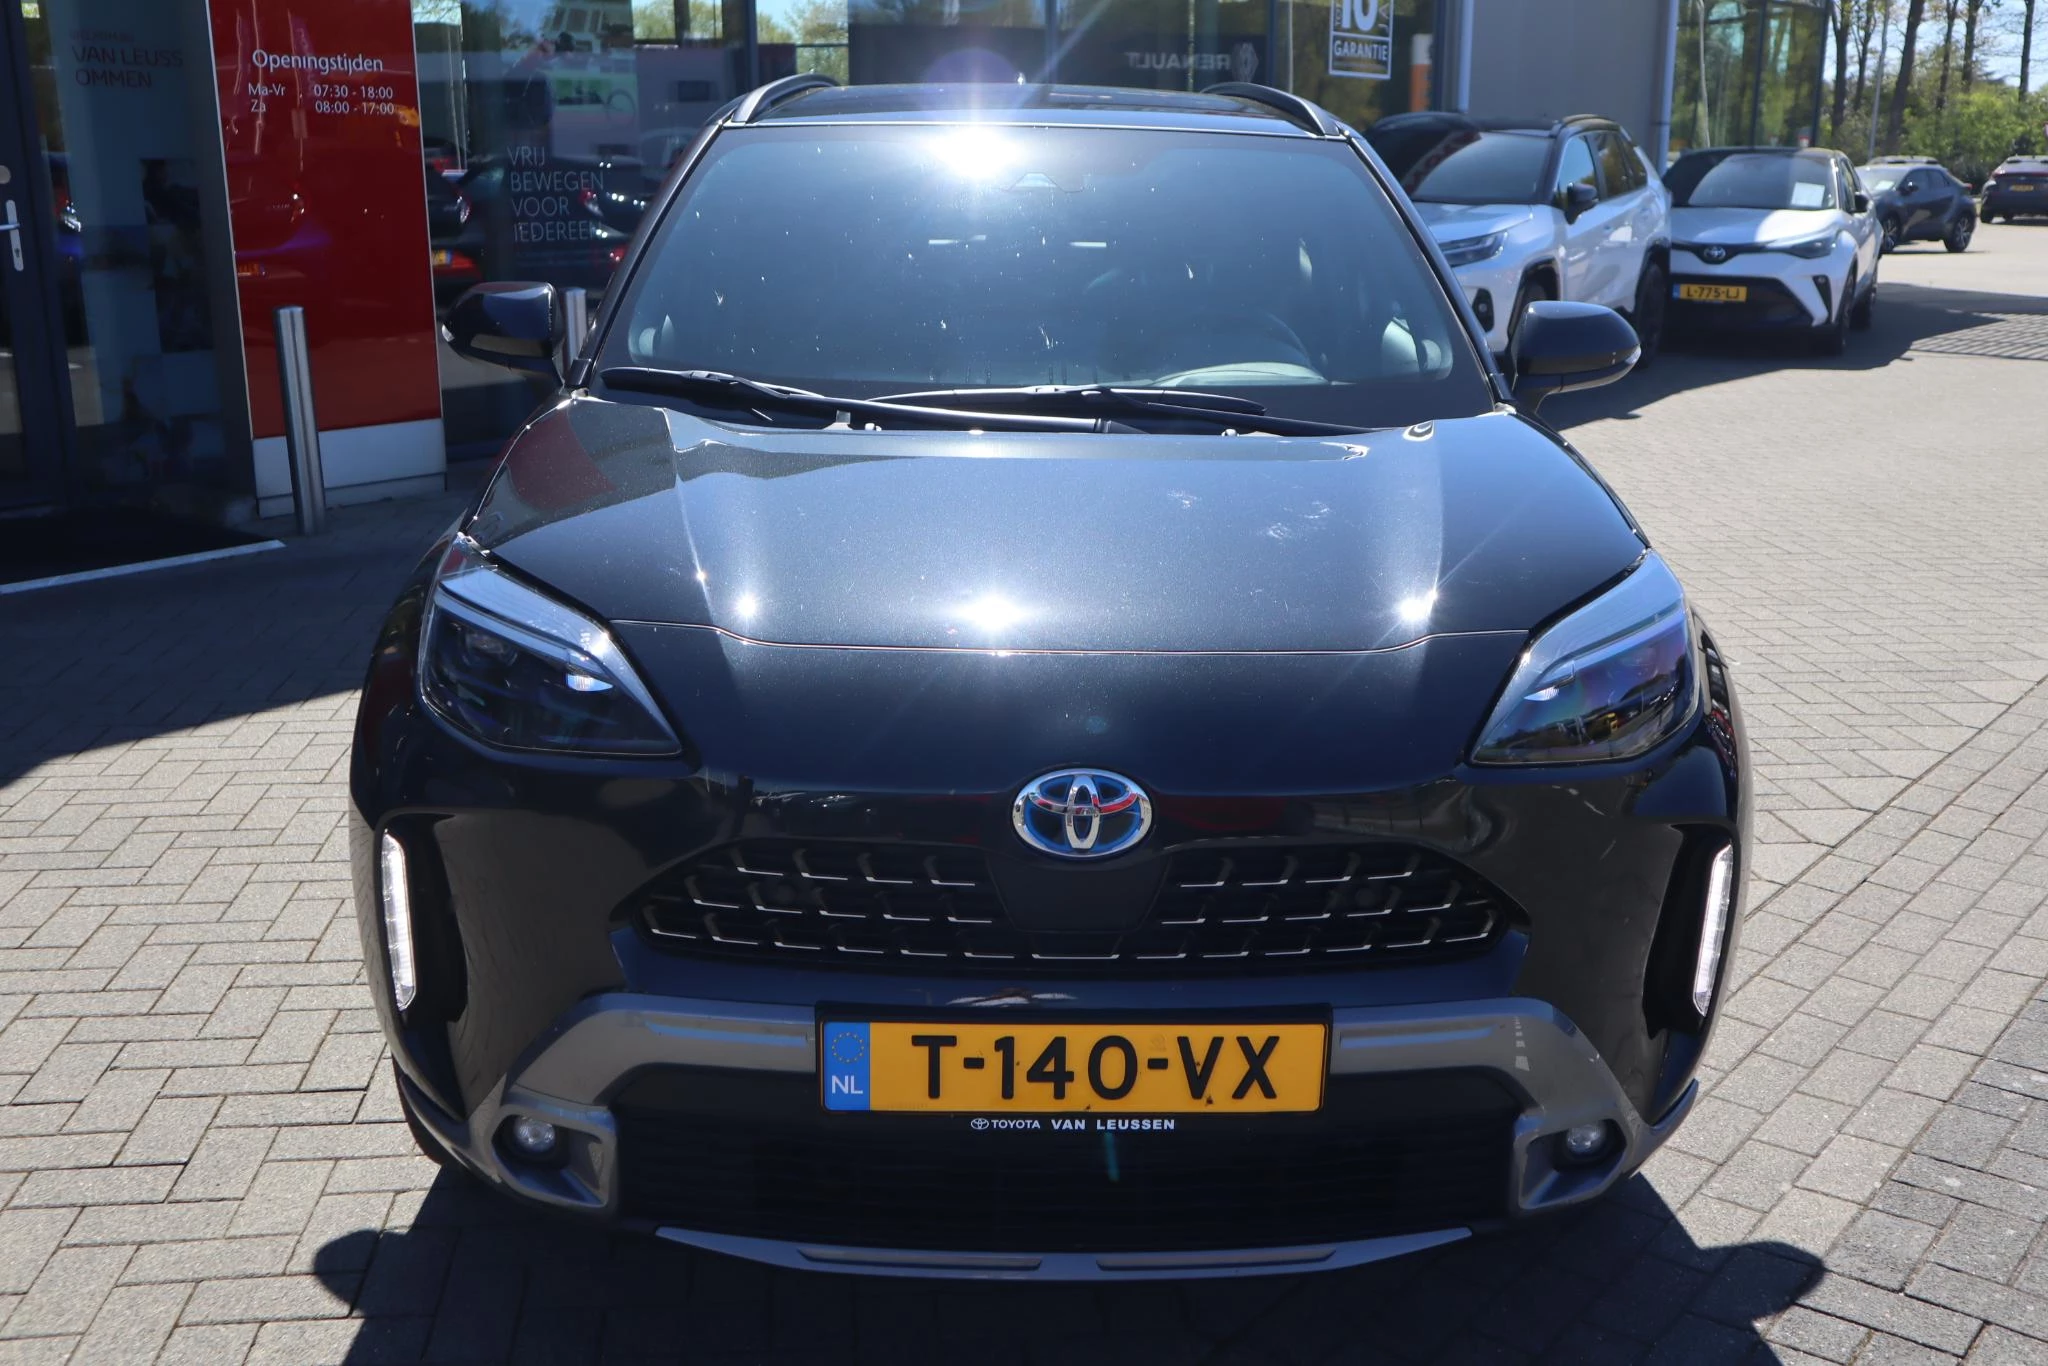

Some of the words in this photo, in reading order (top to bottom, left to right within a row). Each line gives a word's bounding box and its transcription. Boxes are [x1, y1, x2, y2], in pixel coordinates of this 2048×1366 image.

[1341, 0, 1379, 31] 10
[71, 45, 116, 64] VAN
[1334, 40, 1389, 61] GARANTIE
[252, 49, 384, 75] Openingstijden
[75, 67, 153, 88] OMMEN
[248, 83, 286, 97] Ma-Vr
[313, 83, 349, 97] 07:30
[361, 85, 394, 100] 18:00
[250, 99, 267, 113] Za
[315, 99, 350, 114] 08:00
[362, 101, 395, 115] 17:00
[507, 145, 545, 167] VRIJ
[510, 171, 604, 192] BEWEGEN
[511, 196, 570, 217] VOOR
[831, 1075, 864, 1095] NL
[911, 1034, 1280, 1100] T-140-VX
[991, 1119, 1041, 1130] TOYOTA
[1051, 1119, 1087, 1130] VAN
[1096, 1119, 1176, 1130] LEUSSEN
